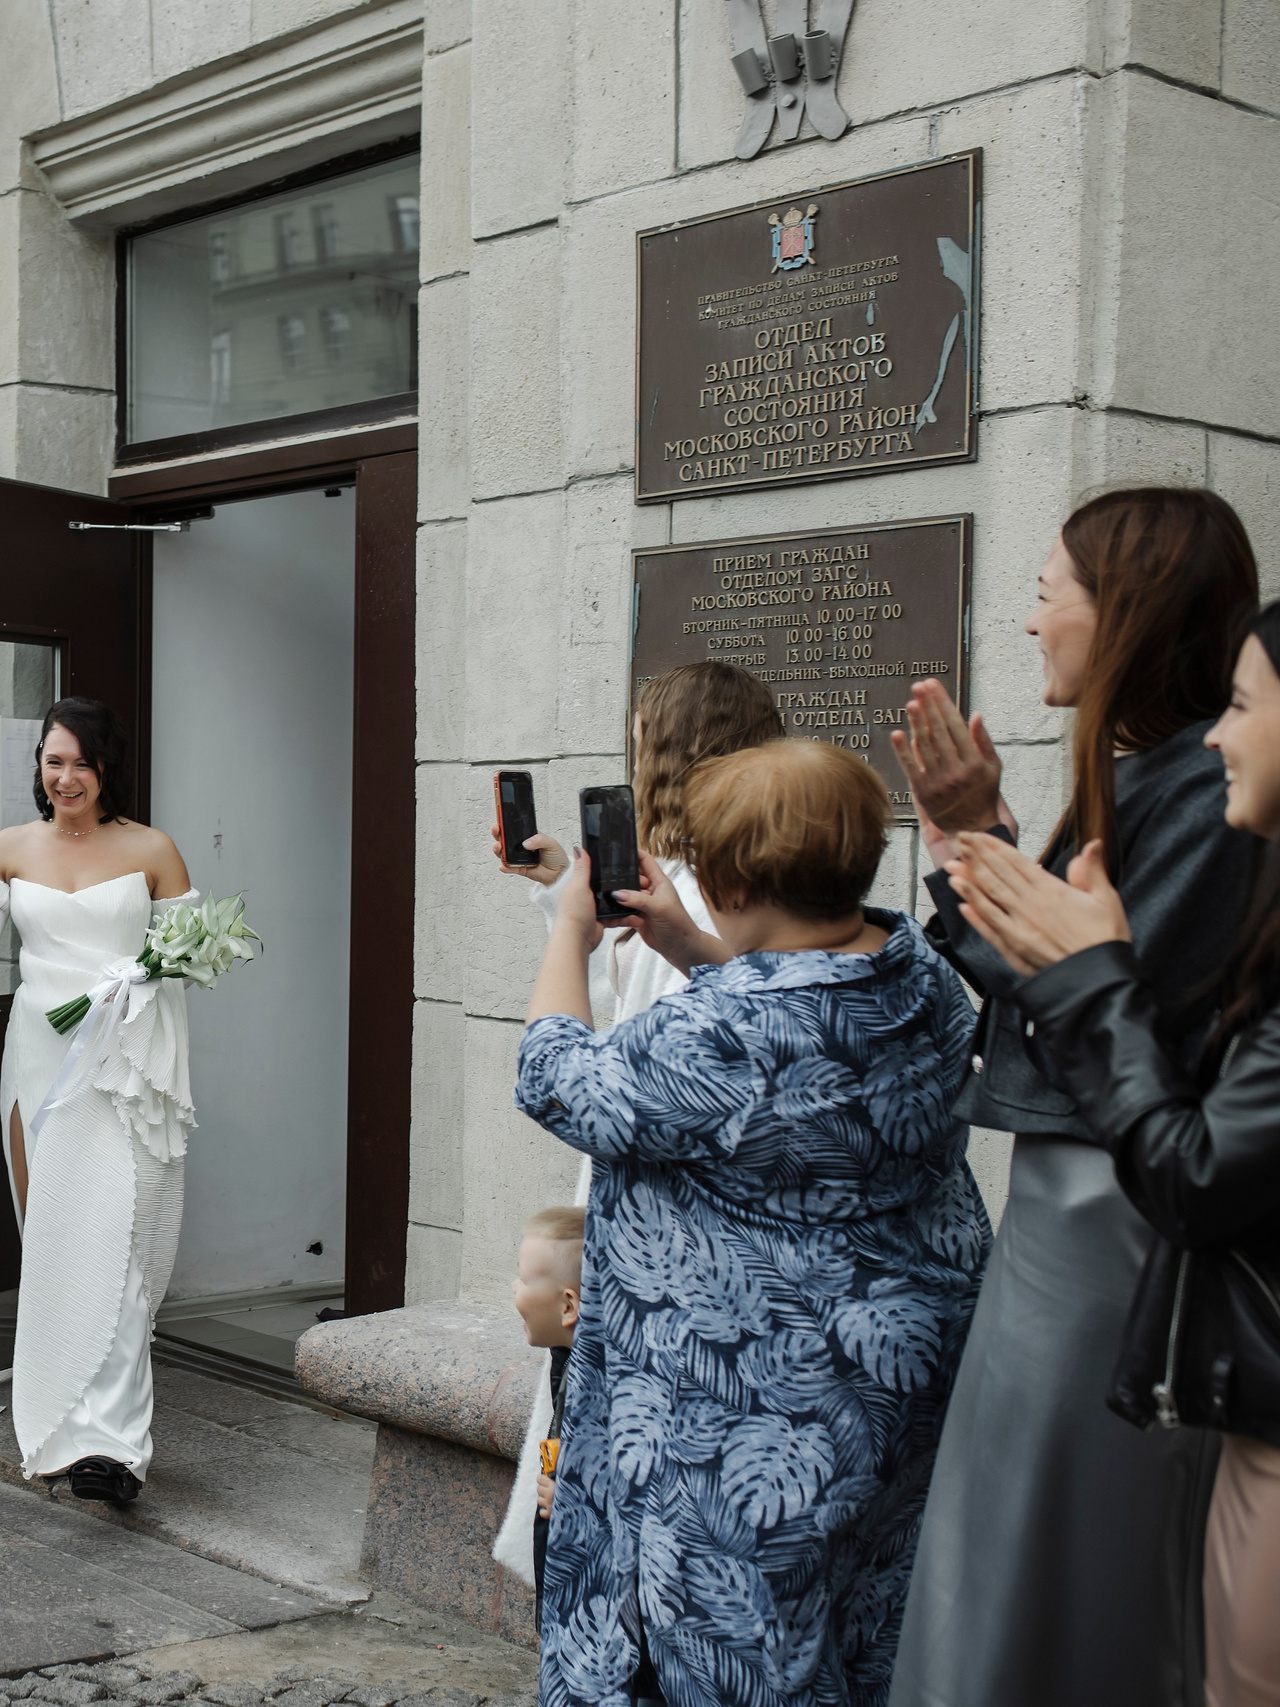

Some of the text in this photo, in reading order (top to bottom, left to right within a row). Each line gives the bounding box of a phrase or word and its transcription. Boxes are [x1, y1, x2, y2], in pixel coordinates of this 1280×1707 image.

[787, 255, 899, 287] САНКТ-ПЕТЕРБУРГА
[749, 299, 762, 310] ПО
[767, 290, 805, 307] ДЕЛАМ
[811, 281, 855, 298] ЗАПИСИ
[862, 271, 898, 287] АКТОВ
[718, 290, 876, 330] ГРАЖДАНСКОГО СОСТОЯНИЯ
[755, 317, 833, 349] ОТДЕЛ
[705, 332, 886, 383] ЗАПИСИ АКТОВ
[699, 358, 893, 408] ГРАЖДАНСКОГО
[724, 387, 865, 427] СОСТОЯНИЯ
[664, 404, 917, 461] МОСКОВСКОГО РАЙОН
[679, 431, 914, 482] САНКТ-ПЕТЕРБУРГА
[713, 543, 869, 573] ПРИЕМ ГРАЖДАН
[721, 565, 858, 592] ОТДЕЛОМ ЗАГС
[691, 580, 893, 611] МОСКОВСКОГО РАЙОНА
[683, 613, 810, 634] ВТОРНИК-ПЯТНИЦА
[708, 635, 766, 649] СУББОТА
[910, 661, 949, 677] ДЕНЬ
[777, 690, 867, 709] ГРАЖДАН
[793, 710, 865, 728] ОТДЕЛА
[873, 708, 908, 724] ЗАГ
